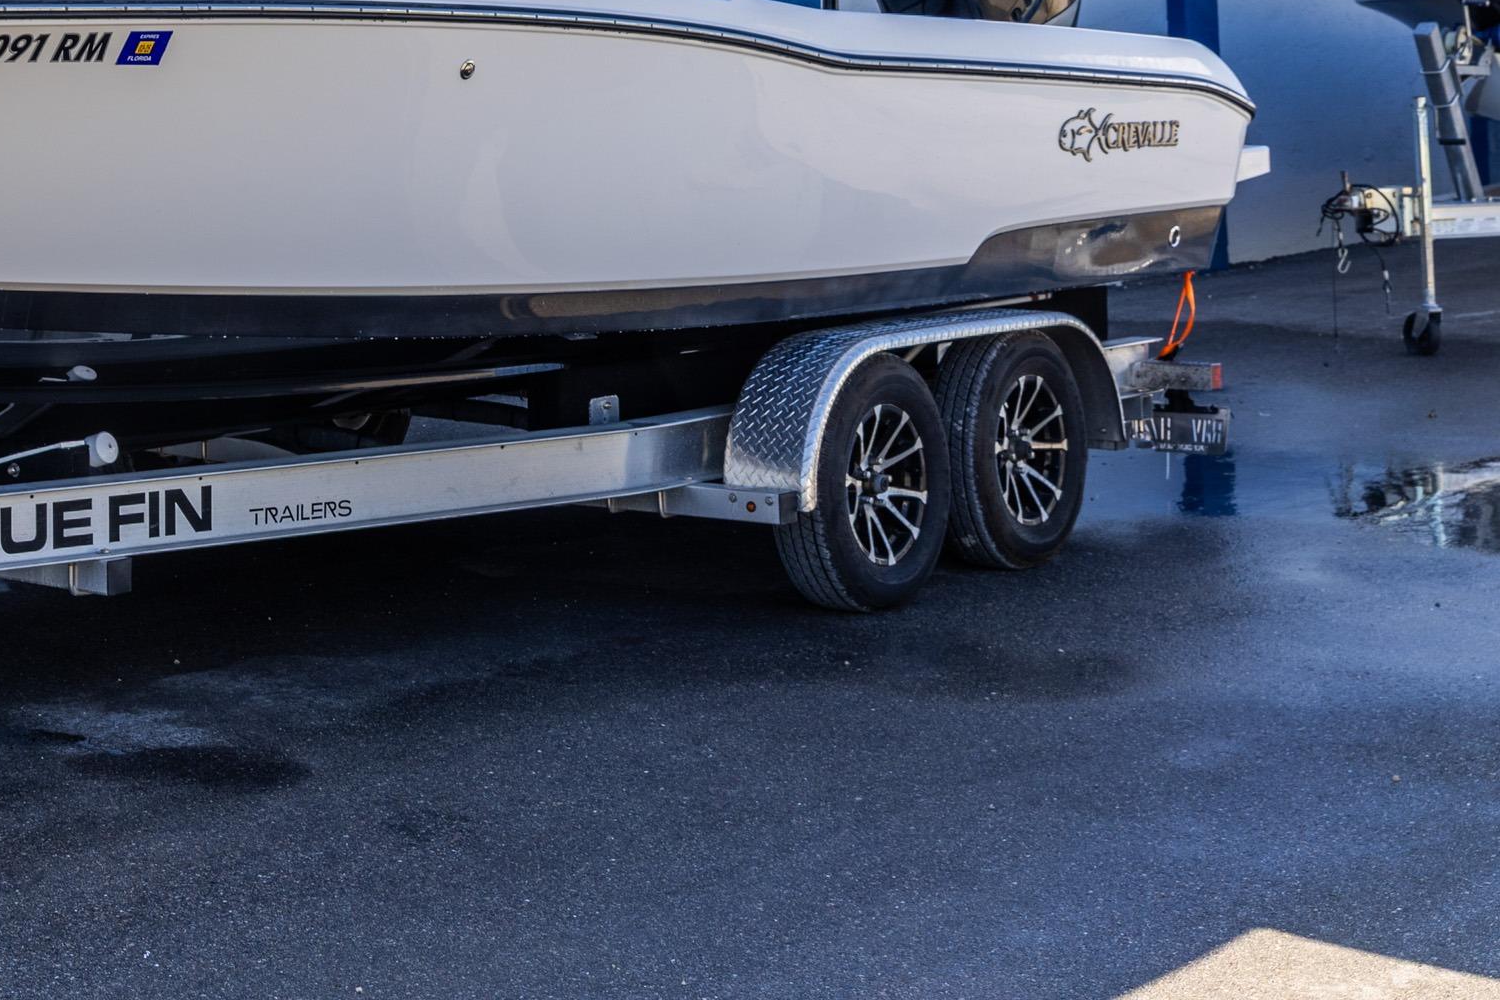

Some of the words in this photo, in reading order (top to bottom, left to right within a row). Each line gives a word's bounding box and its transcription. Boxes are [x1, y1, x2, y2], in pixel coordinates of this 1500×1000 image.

[50, 31, 113, 63] RM
[127, 54, 153, 62] FLORIDA
[1105, 120, 1179, 150] CREVALLE
[108, 485, 213, 543] FIN
[249, 500, 353, 526] TRAILERS
